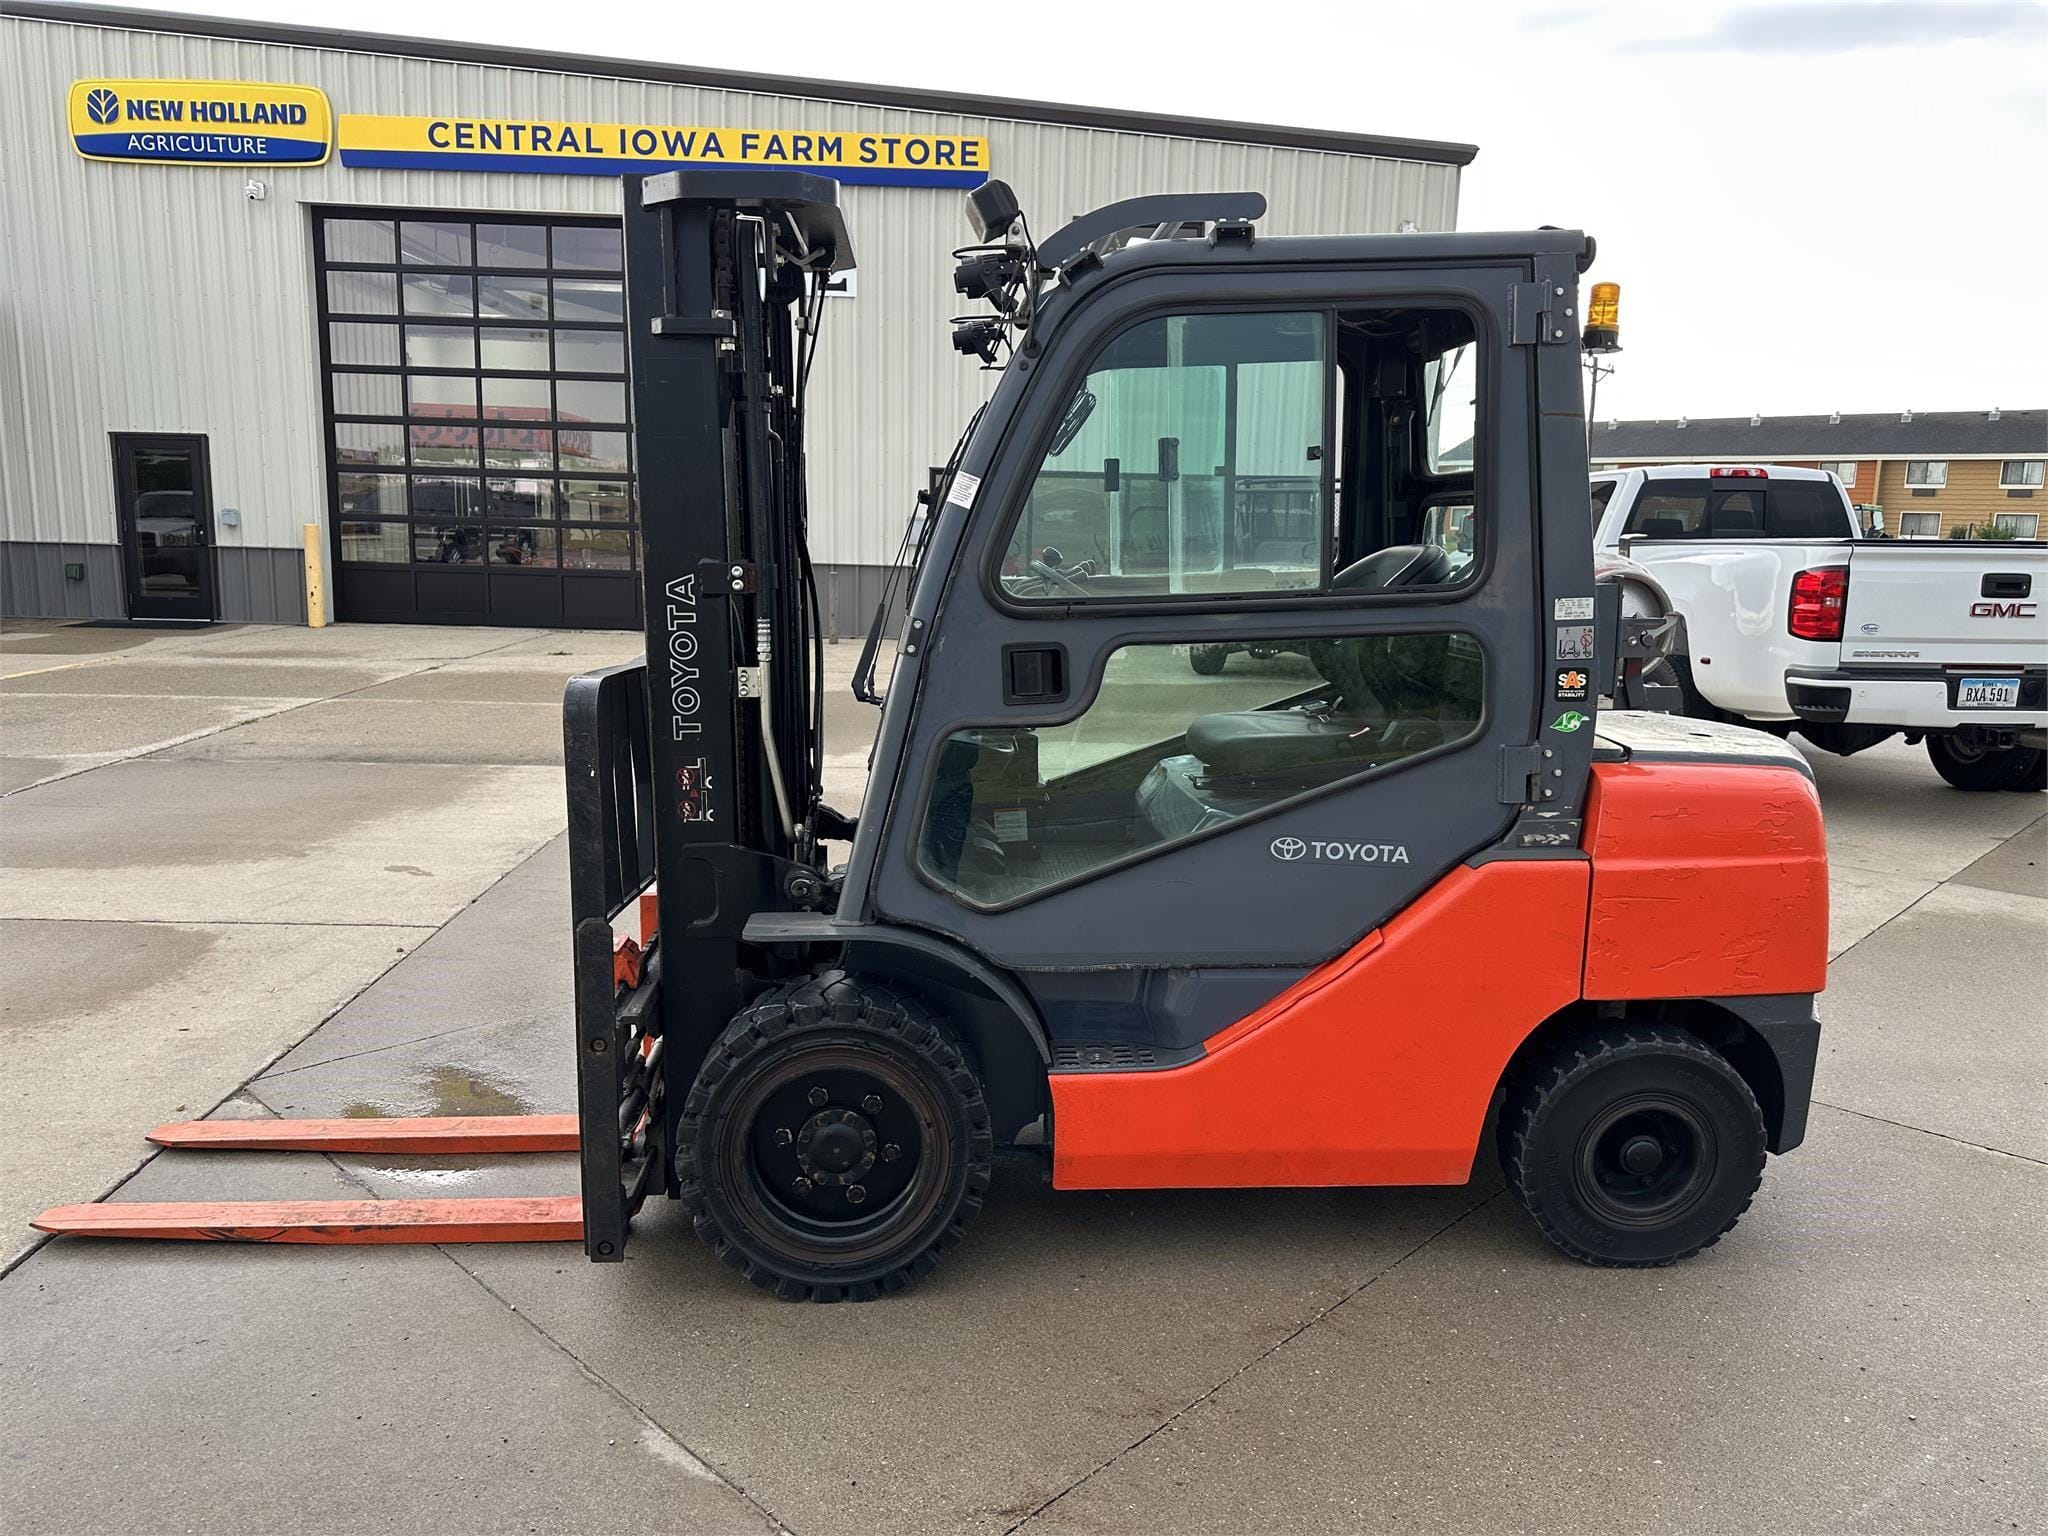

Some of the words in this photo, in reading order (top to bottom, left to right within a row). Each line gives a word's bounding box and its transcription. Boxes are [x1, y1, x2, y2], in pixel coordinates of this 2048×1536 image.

[126, 98, 184, 121] NEW
[190, 101, 307, 125] HOLLAND
[127, 134, 267, 154] AGRICULTURE
[428, 121, 603, 153] CENTRAL
[619, 128, 725, 158] IOWA
[741, 133, 842, 162] FARM
[859, 138, 979, 167] STORE
[1969, 602, 2038, 618] GMC
[665, 573, 702, 741] TOYOTA
[1558, 671, 1587, 689] SAS
[1965, 687, 1986, 702] BXA
[1989, 687, 2009, 702] 591
[1311, 841, 1410, 864] TOYOTA
